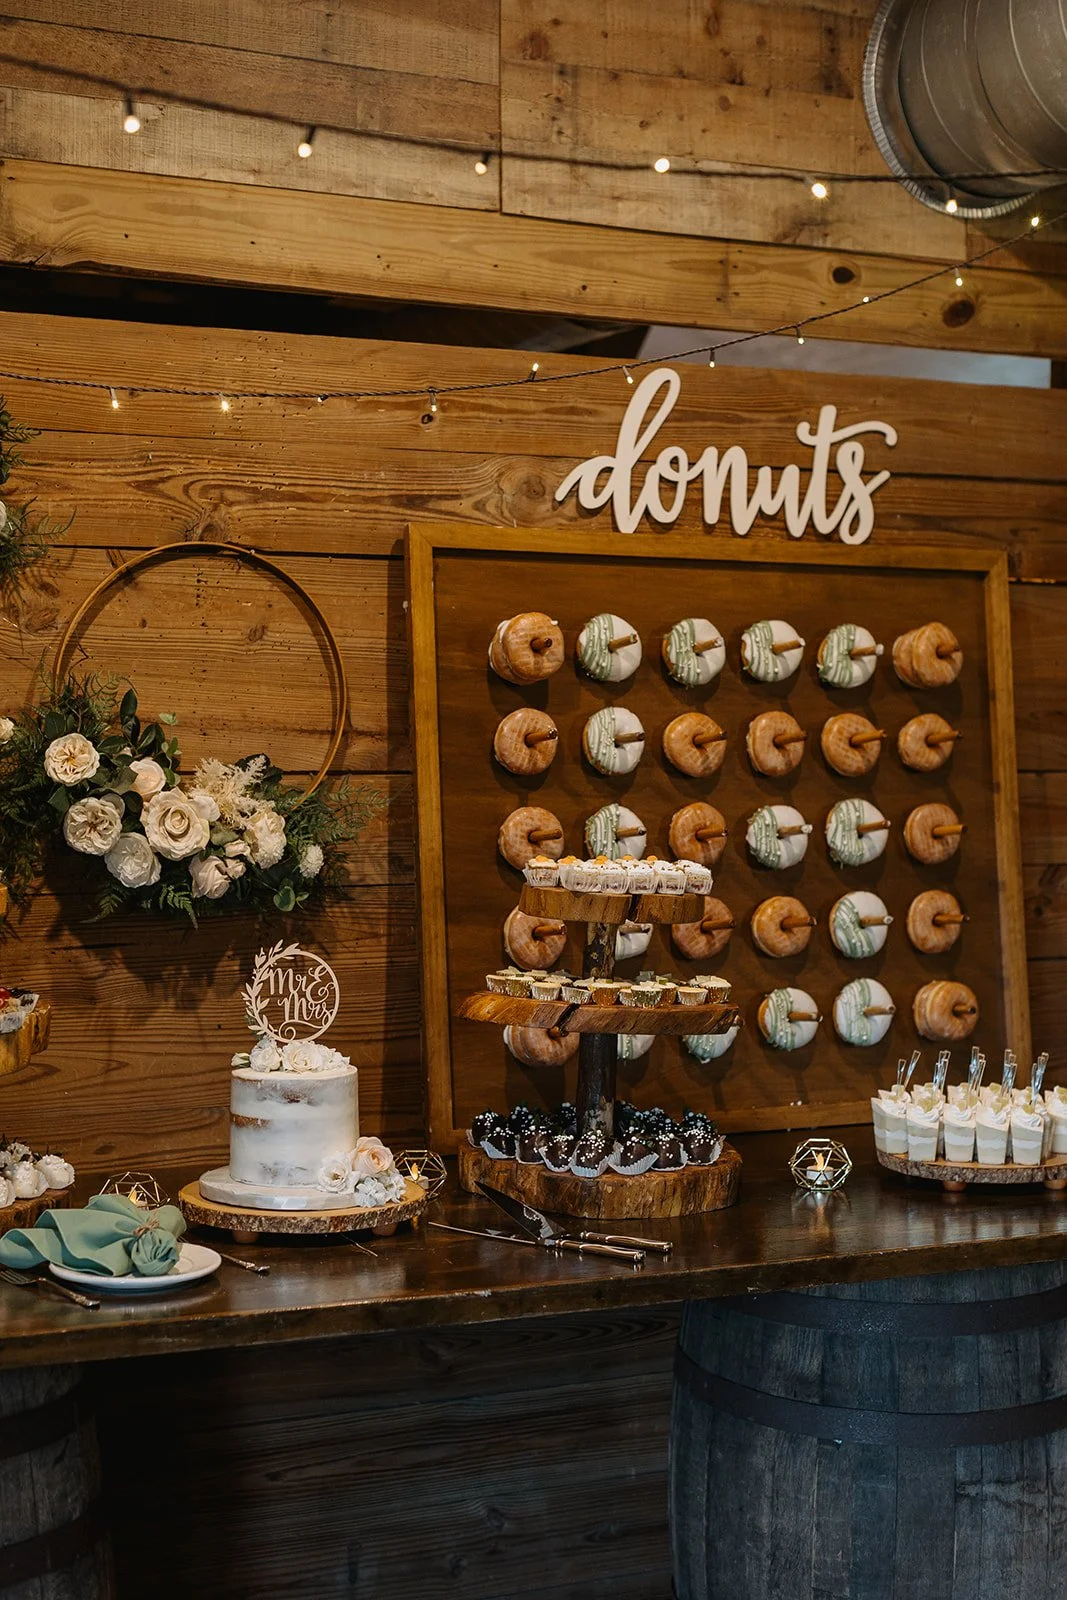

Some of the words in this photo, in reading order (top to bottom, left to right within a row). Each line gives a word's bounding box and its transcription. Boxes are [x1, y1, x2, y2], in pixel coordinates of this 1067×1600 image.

[555, 367, 898, 545] donuts
[269, 967, 307, 995] Mr
[305, 965, 335, 1004] &
[277, 991, 334, 1027] Mrs
